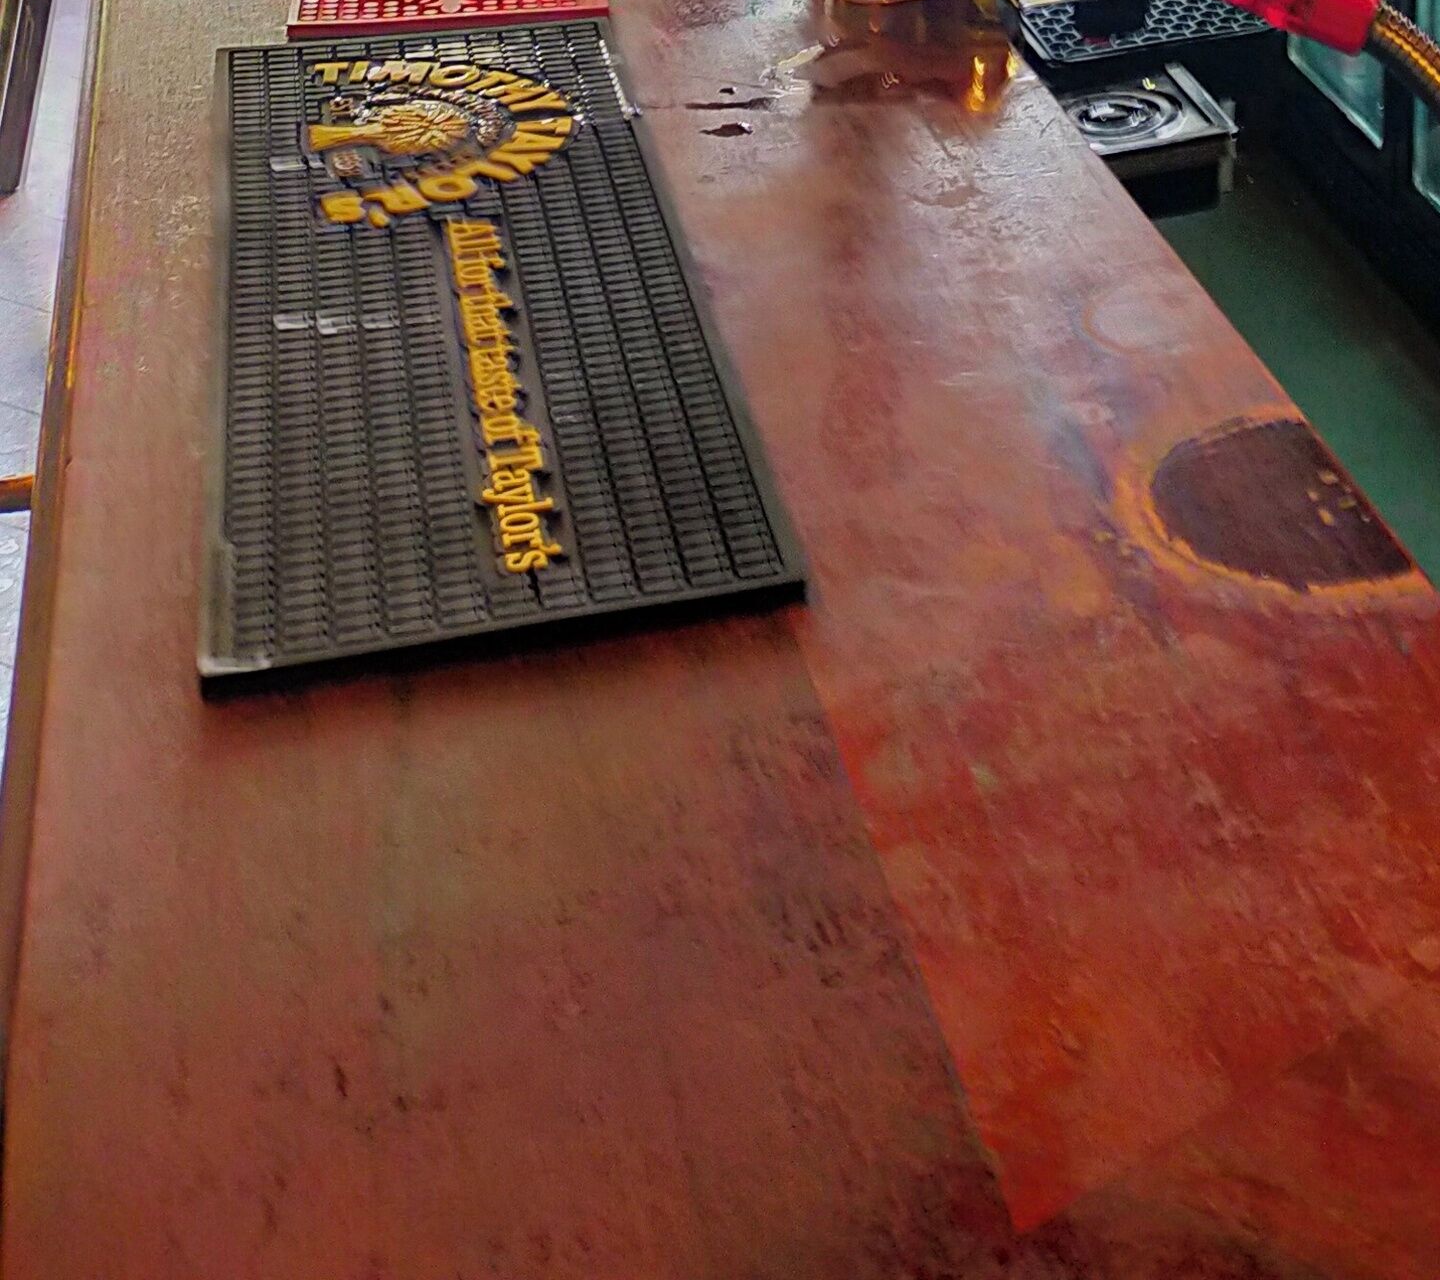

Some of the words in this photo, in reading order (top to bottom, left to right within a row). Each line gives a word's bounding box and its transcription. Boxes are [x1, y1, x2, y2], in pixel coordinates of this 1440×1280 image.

[312, 59, 570, 114] TIMOTHY
[319, 115, 575, 229] TAYLOR'S
[482, 444, 563, 575] Taylor's
